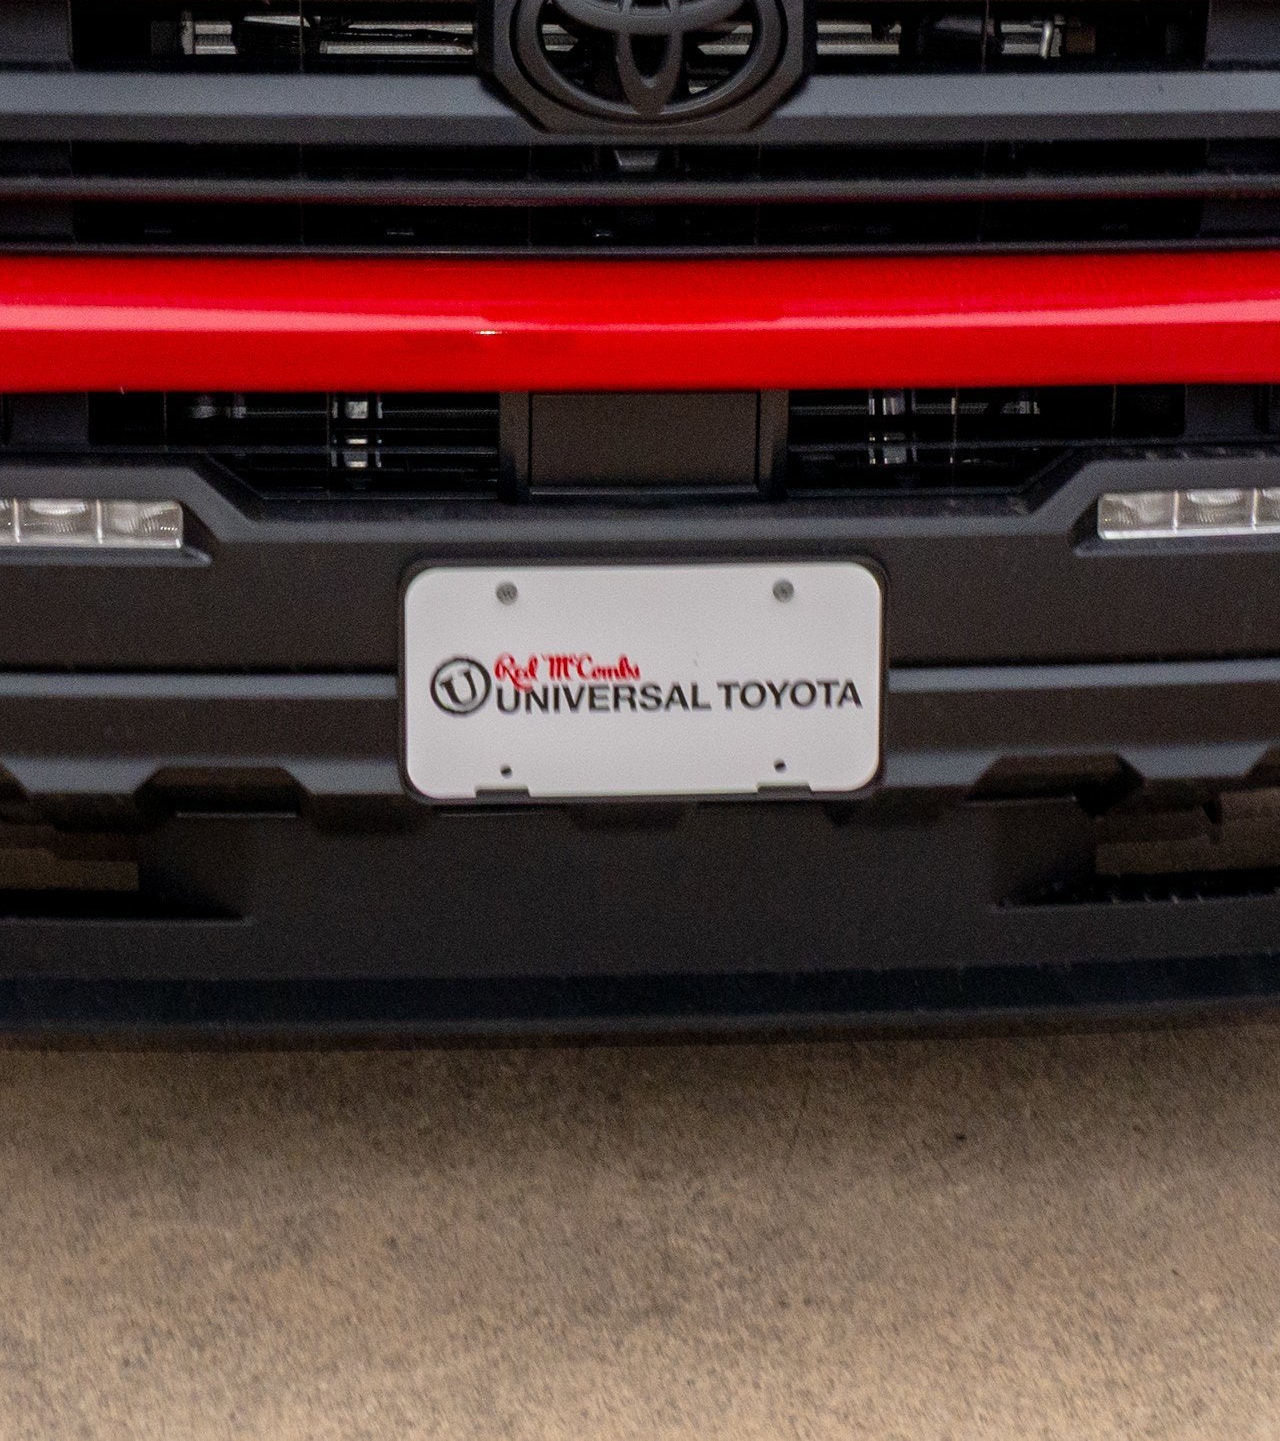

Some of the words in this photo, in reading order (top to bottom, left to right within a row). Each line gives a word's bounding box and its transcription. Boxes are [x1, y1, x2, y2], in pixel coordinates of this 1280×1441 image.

[494, 652, 539, 693] Red
[496, 679, 712, 715] UNIVERSAL
[716, 678, 864, 711] TOYOTA
